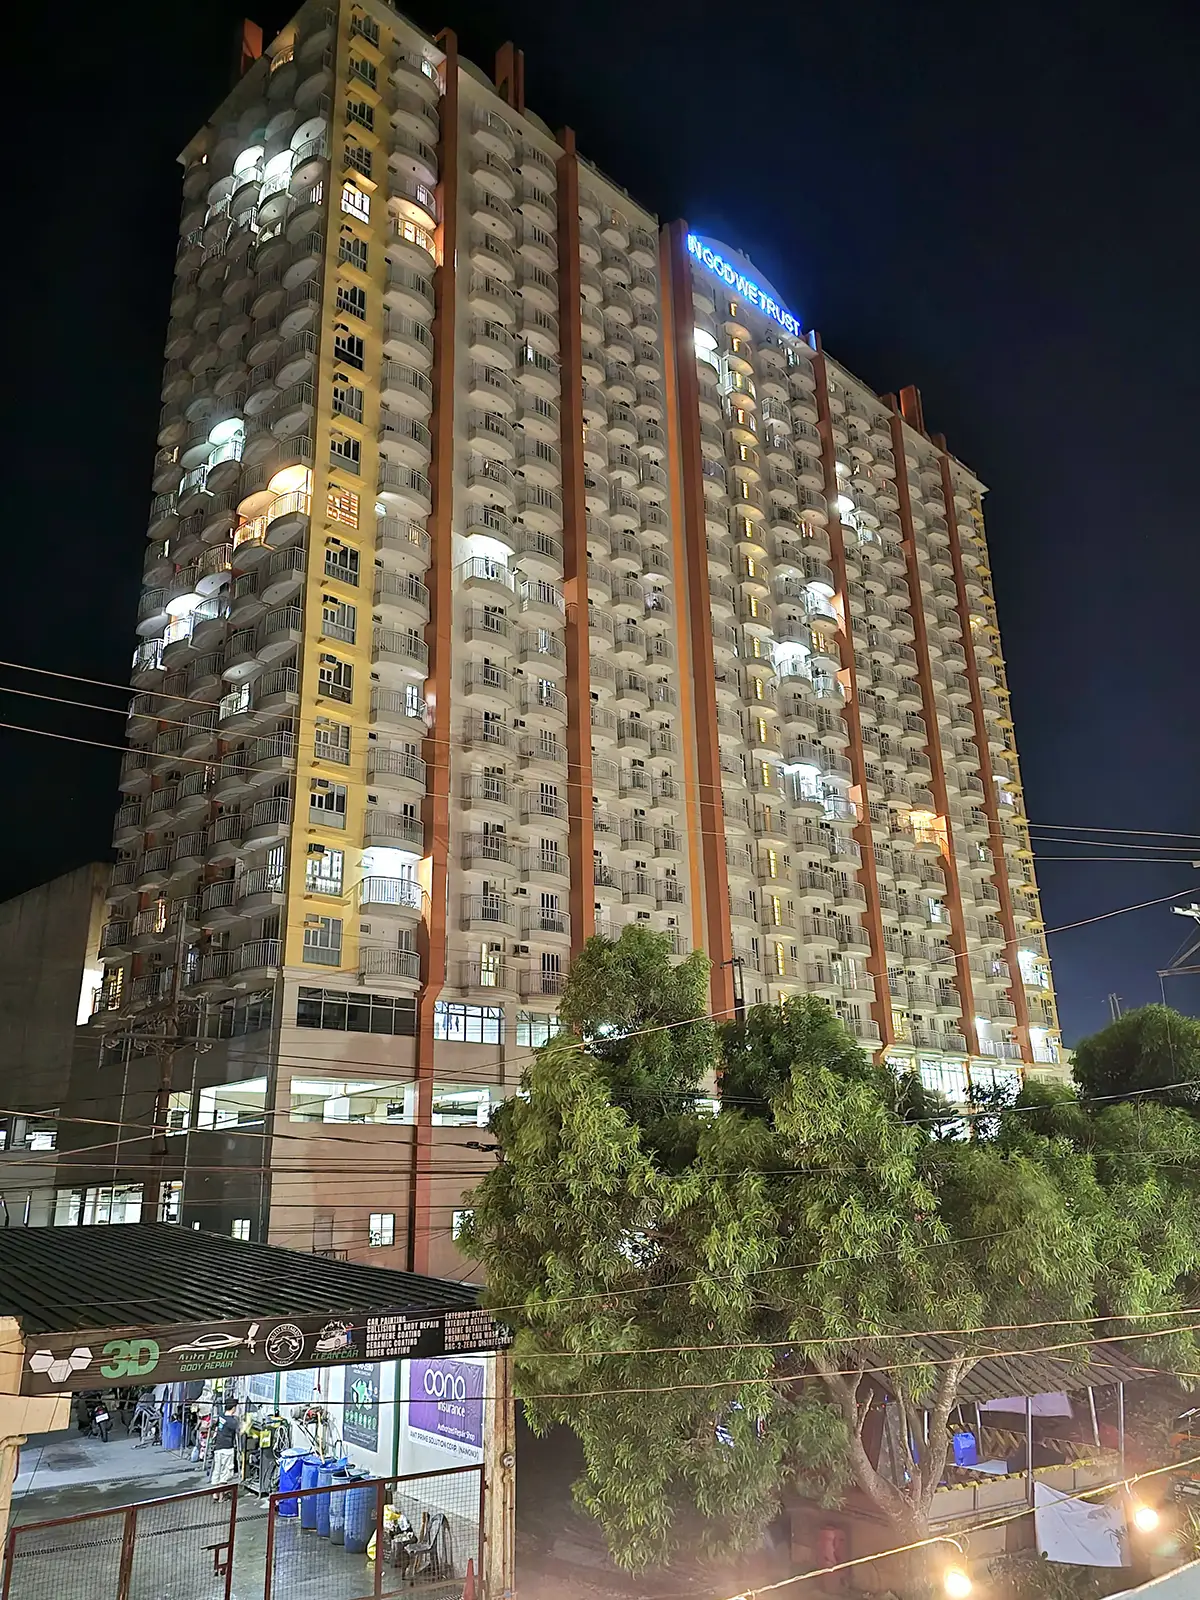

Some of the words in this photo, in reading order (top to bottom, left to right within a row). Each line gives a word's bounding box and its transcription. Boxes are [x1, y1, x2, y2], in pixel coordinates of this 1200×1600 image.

[688, 234, 702, 259] IN
[702, 249, 735, 285] GOD
[733, 271, 758, 304] WE
[757, 290, 800, 336] TRUST
[366, 1324, 396, 1333] COLLISION
[403, 1322, 418, 1331] BODY
[420, 1320, 440, 1330] REPAIR
[367, 1317, 379, 1326] CAR
[380, 1315, 407, 1325] PAINTING
[444, 1318, 469, 1328] INTERIOR
[366, 1332, 396, 1341] GRAPHENE
[397, 1329, 421, 1339] COATING
[444, 1325, 464, 1335] ENGINE
[465, 1323, 492, 1333] DETAILING
[366, 1340, 393, 1350] CERAMIC
[393, 1337, 418, 1347] COATING
[444, 1333, 471, 1343] PREMIUM
[472, 1332, 483, 1340] CAR
[178, 1352, 204, 1362] Auto
[208, 1349, 239, 1361] Paint
[340, 1349, 359, 1359] CAR
[365, 1348, 385, 1358] UNDER
[386, 1346, 411, 1356] COATING
[100, 1339, 160, 1379] 3D
[180, 1361, 203, 1372] BODY
[204, 1360, 234, 1371] REPAIR
[424, 1368, 466, 1403] oona
